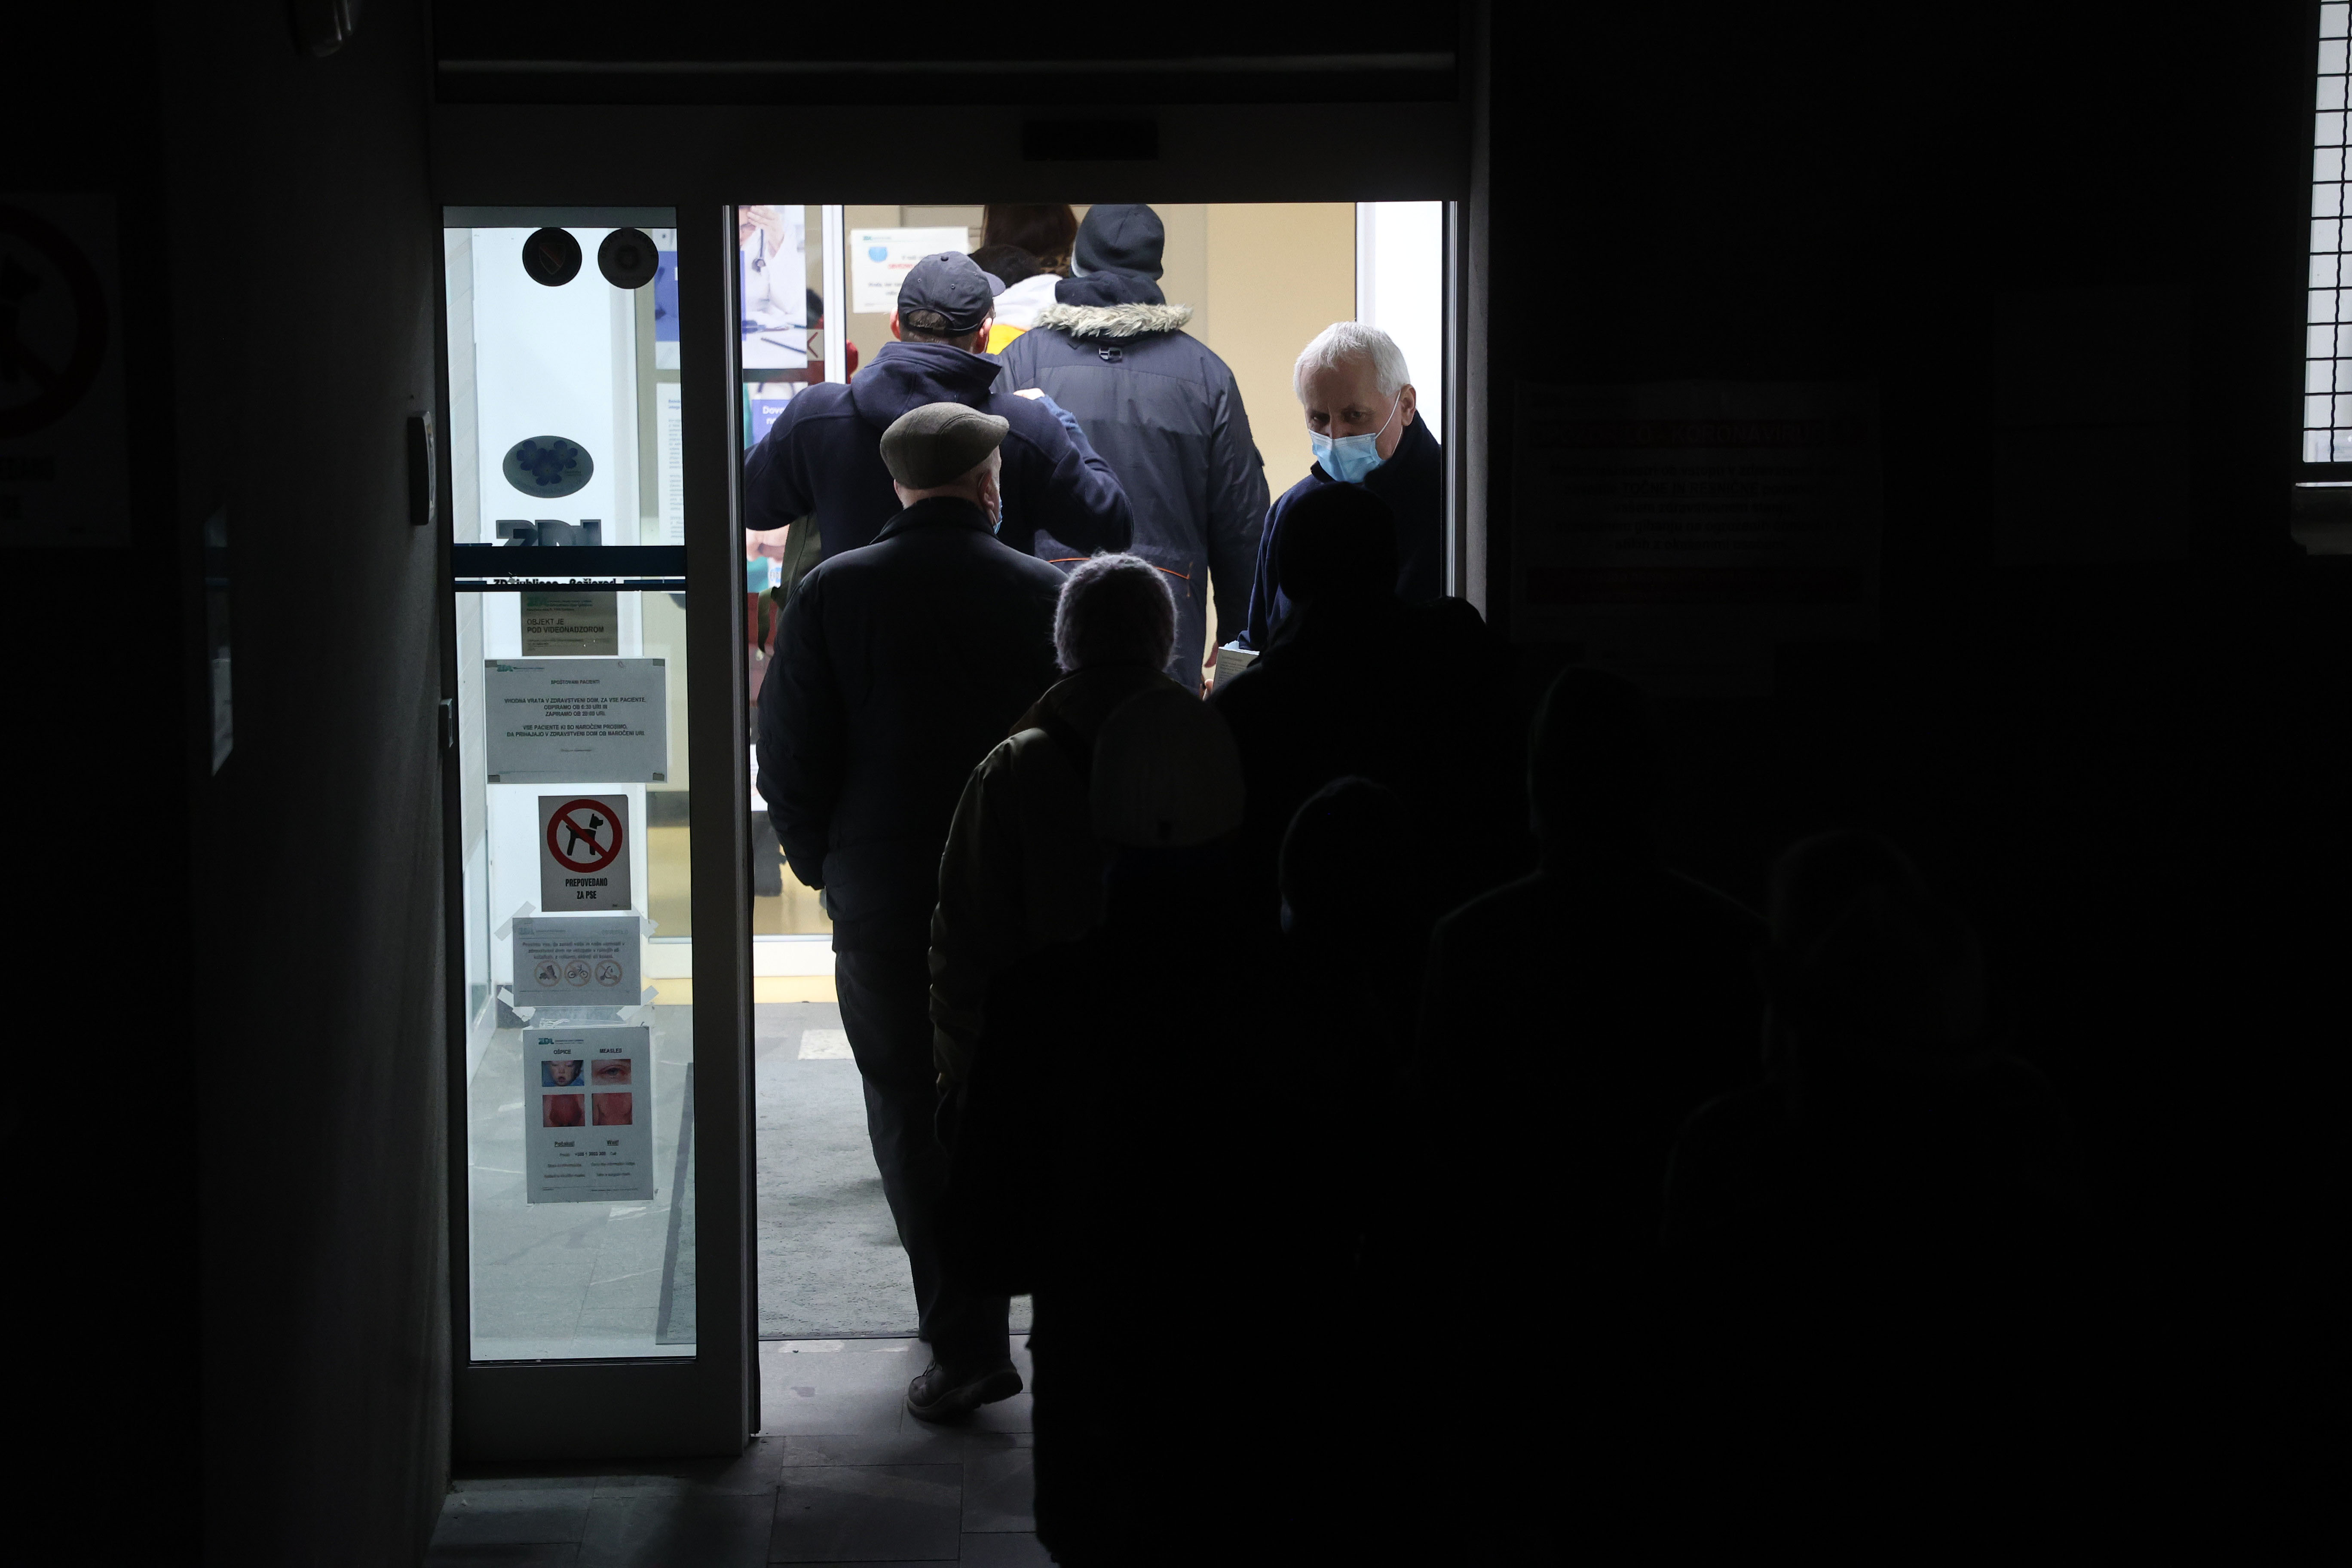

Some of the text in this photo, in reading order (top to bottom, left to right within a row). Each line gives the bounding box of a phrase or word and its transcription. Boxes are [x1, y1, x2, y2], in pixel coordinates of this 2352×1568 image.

[565, 878, 608, 887] PREPOVEDANO
[577, 891, 597, 900] ZA PSE
